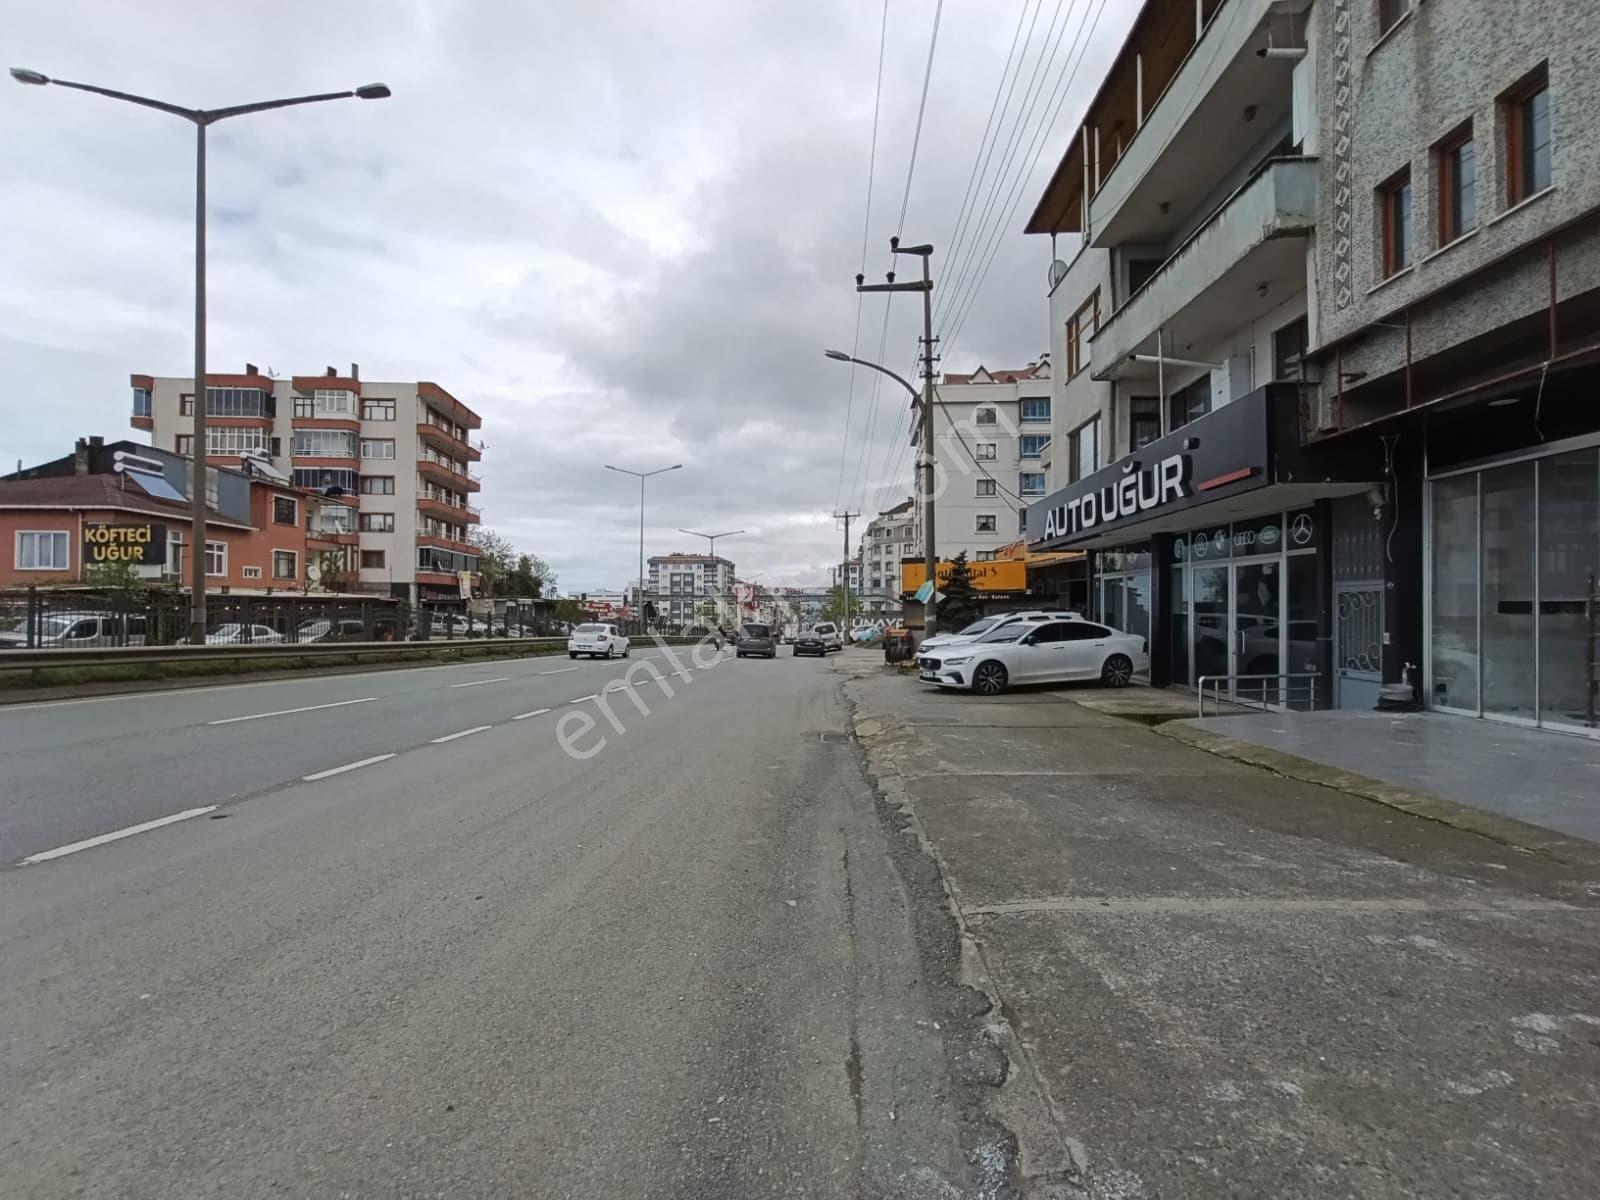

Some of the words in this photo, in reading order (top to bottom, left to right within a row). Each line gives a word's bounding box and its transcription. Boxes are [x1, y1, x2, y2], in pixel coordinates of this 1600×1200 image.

[1044, 493, 1096, 540] AUTO
[1101, 454, 1184, 522] UĞUR
[85, 524, 151, 543] KÖFTECİ
[93, 542, 144, 561] UĞUR
